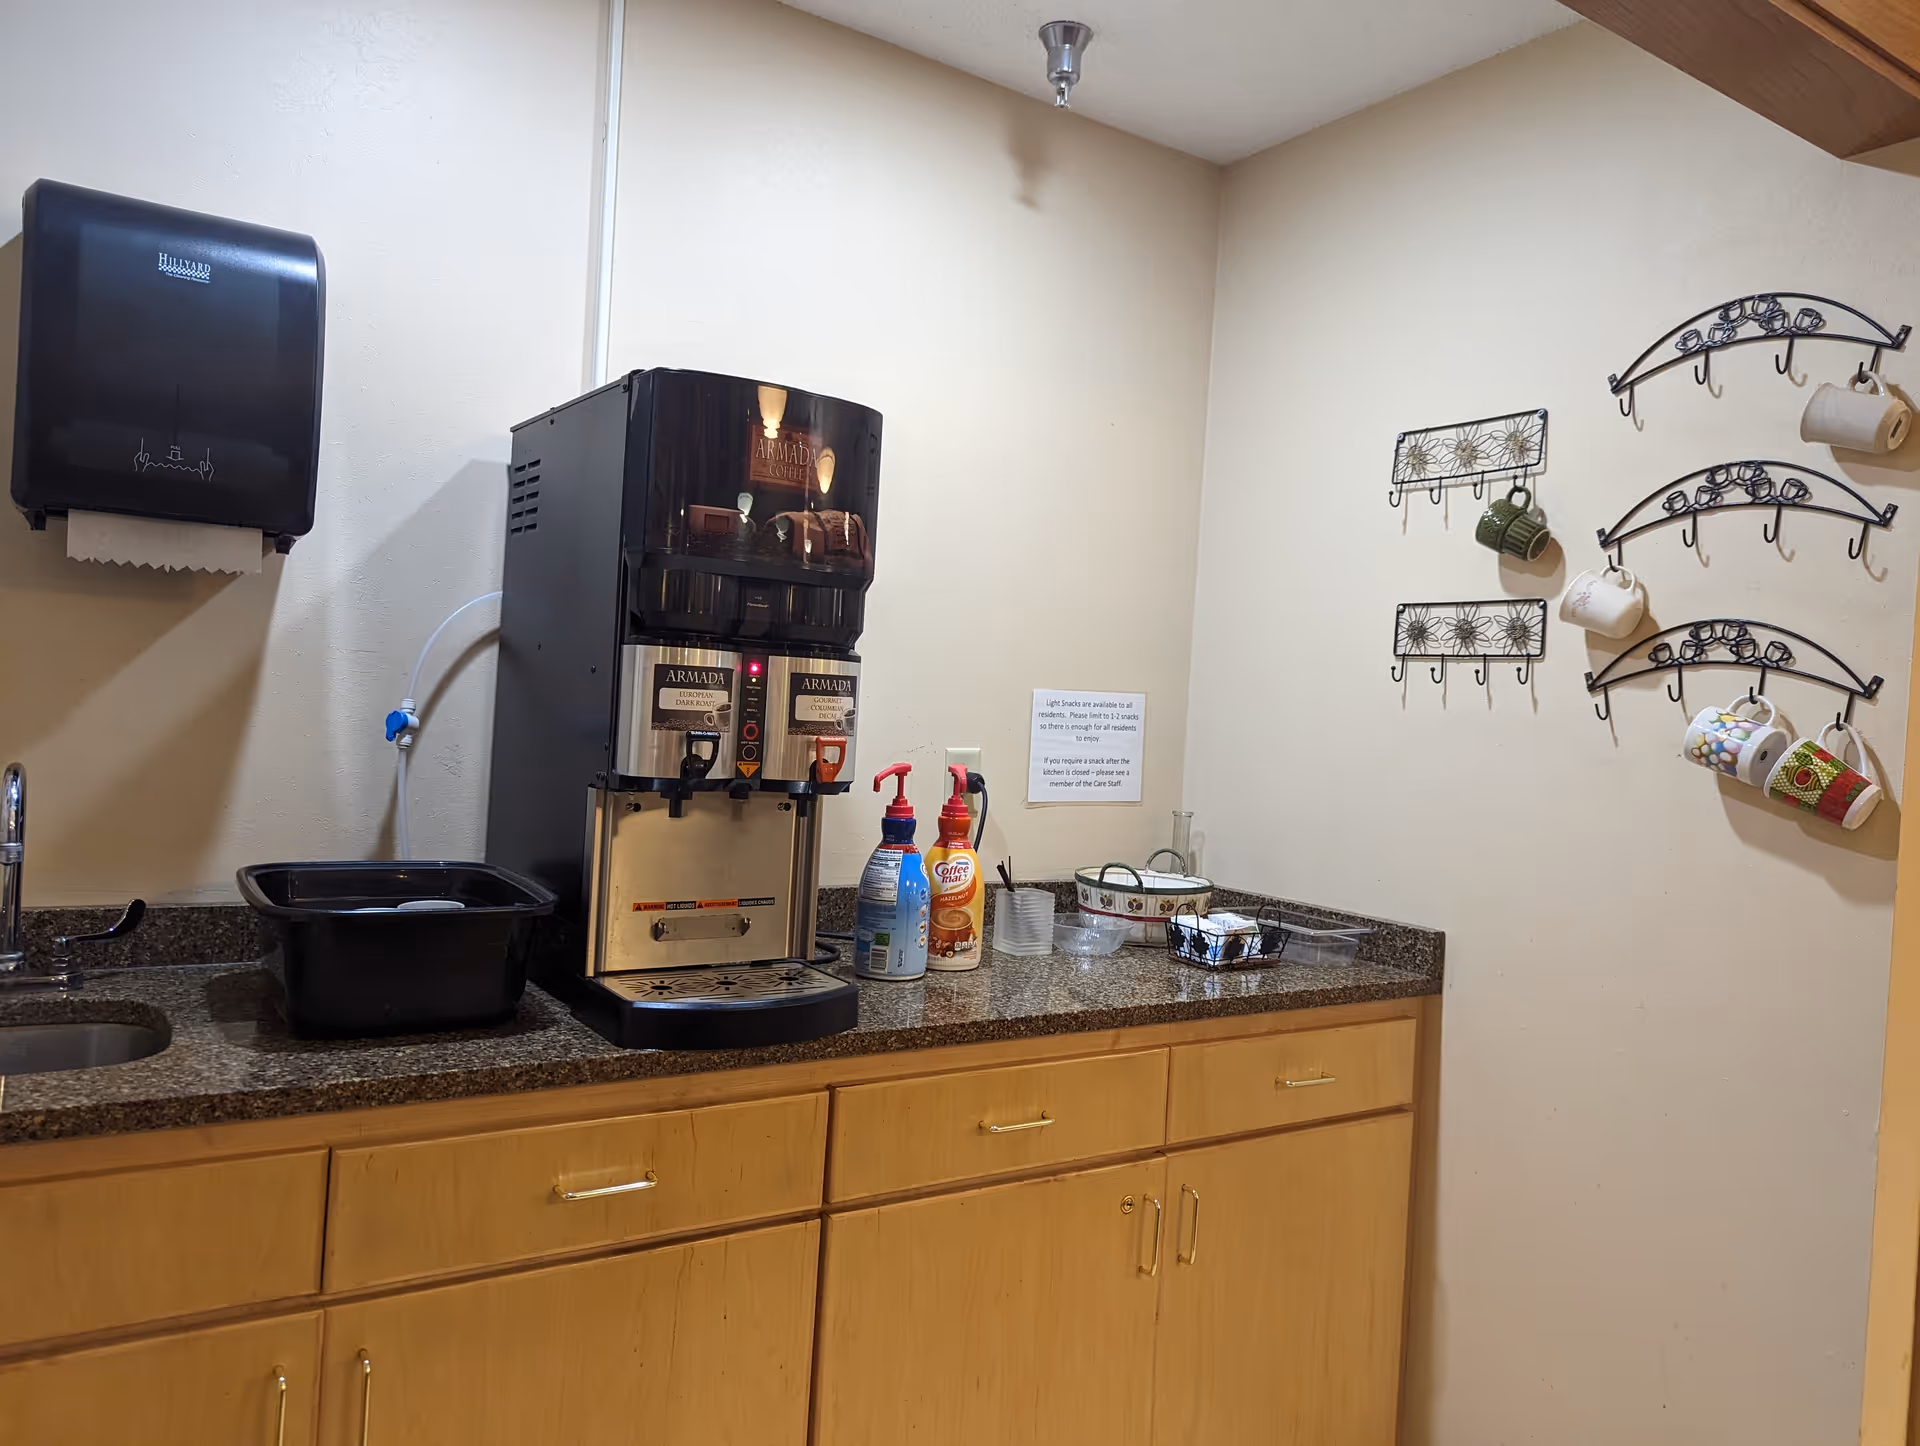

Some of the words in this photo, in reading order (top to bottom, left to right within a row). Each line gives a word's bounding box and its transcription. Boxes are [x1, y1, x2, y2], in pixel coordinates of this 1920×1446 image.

[159, 252, 211, 272] HILLYARD
[755, 438, 818, 469] ARMADA
[769, 463, 804, 480] COFFEE
[665, 669, 725, 685] ARMADA
[801, 678, 851, 692] ARMADA
[679, 691, 713, 699] EUROPEAN
[1047, 699, 1060, 707] Light
[1065, 722, 1069, 730] is
[1071, 723, 1092, 731] enough
[1062, 757, 1082, 765] require
[934, 861, 970, 877] Coffee
[940, 891, 969, 902] HAZELNUT
